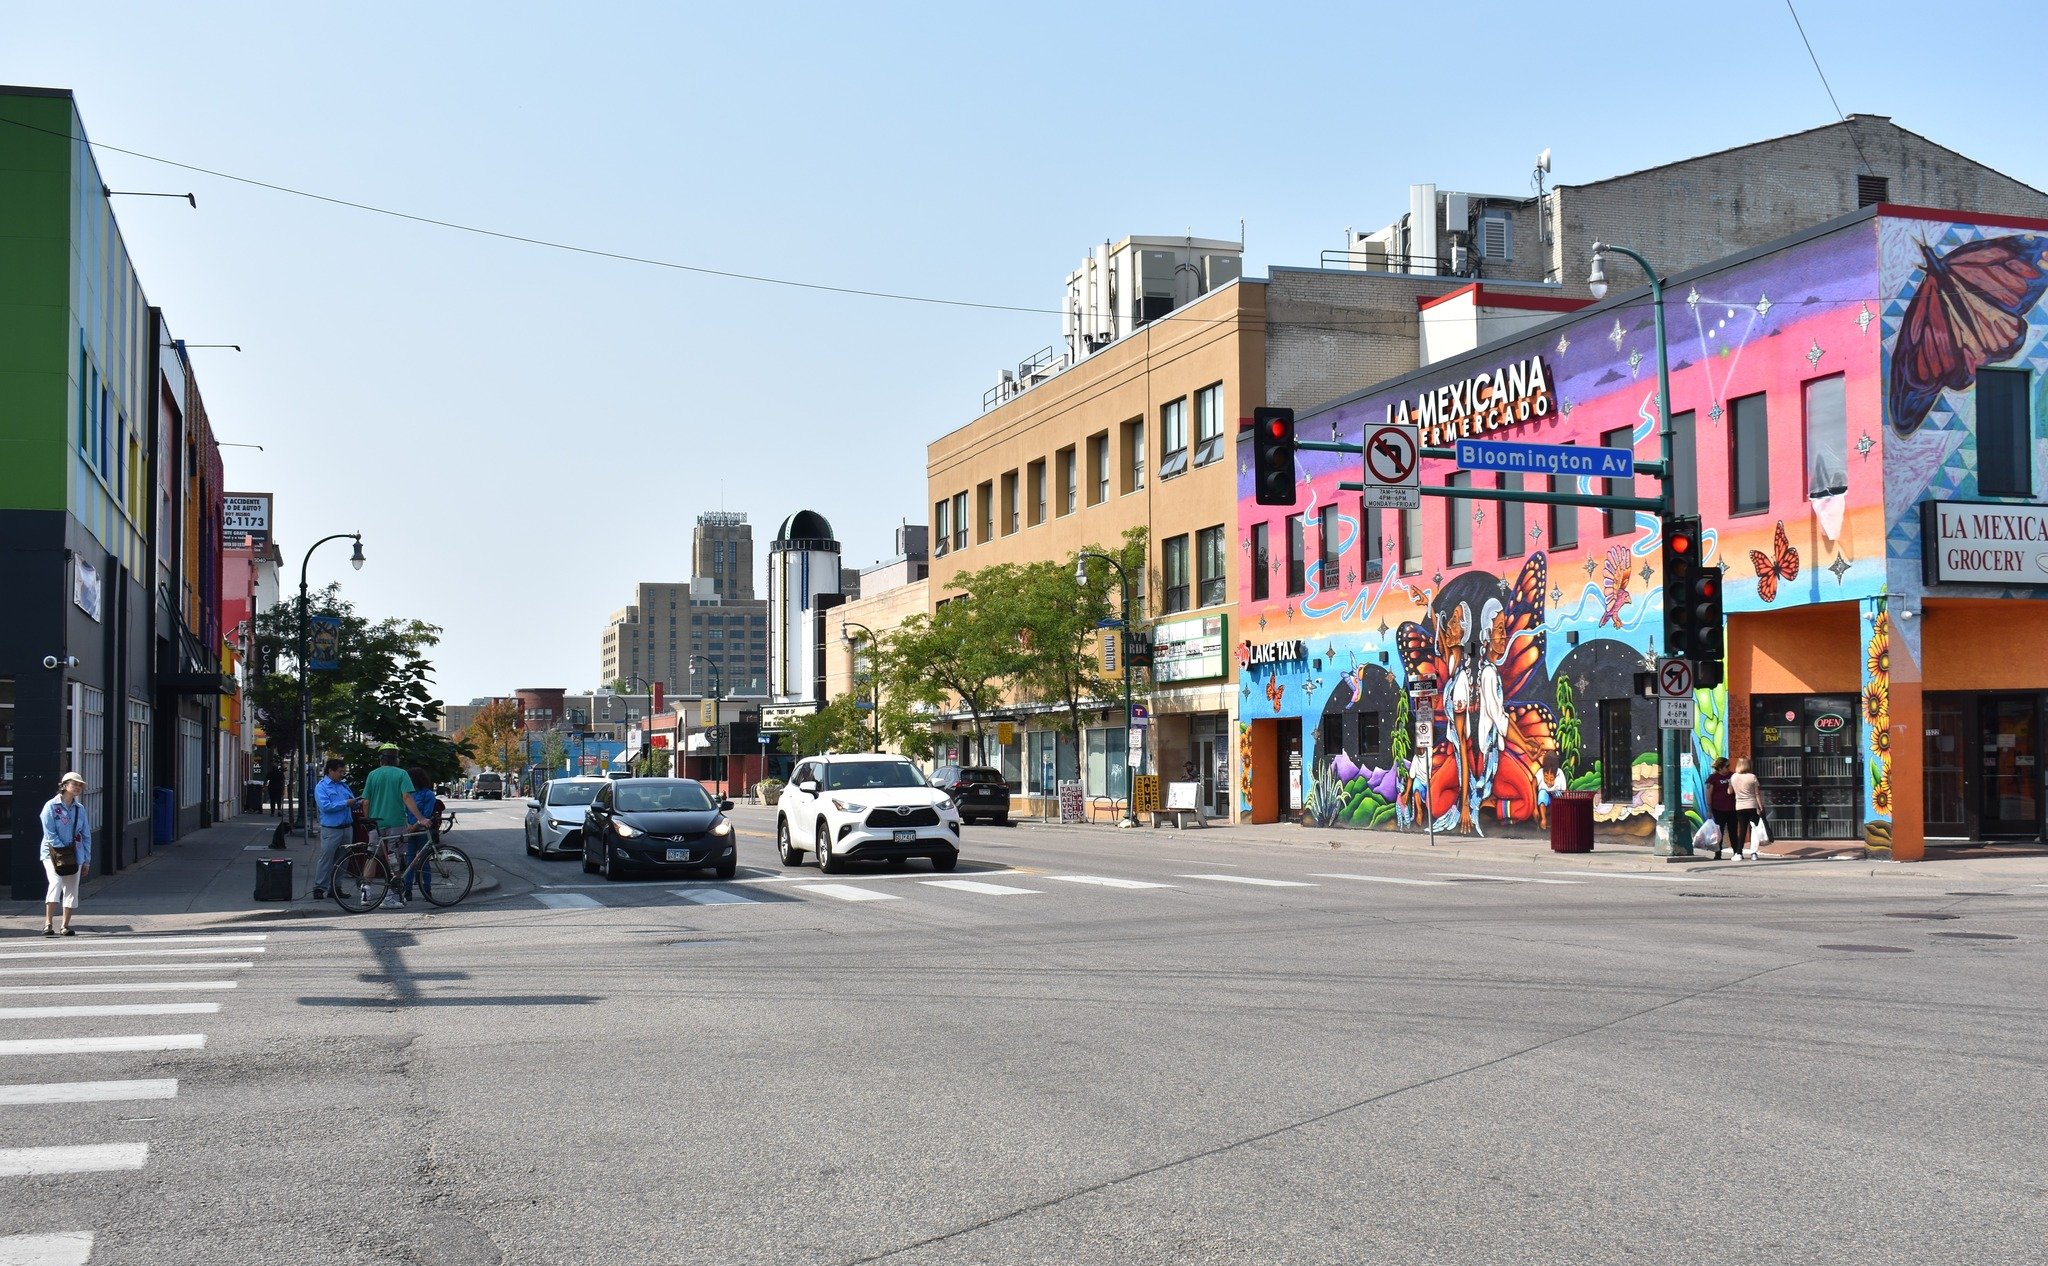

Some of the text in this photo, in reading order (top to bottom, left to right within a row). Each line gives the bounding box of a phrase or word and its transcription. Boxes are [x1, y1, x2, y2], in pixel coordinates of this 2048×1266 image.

[1418, 355, 1547, 430] MEXICANA
[1420, 396, 1548, 448] ERMERCADO
[1462, 446, 1627, 474] Bloomington Av
[1941, 513, 2048, 541] LA MEXICA
[1948, 549, 2025, 571] GROCERY
[1104, 634, 1115, 671] MIDTOWN
[1130, 644, 1148, 654] RDE
[1250, 640, 1297, 664] LAKE TAX
[1817, 719, 1841, 728] OPEN
